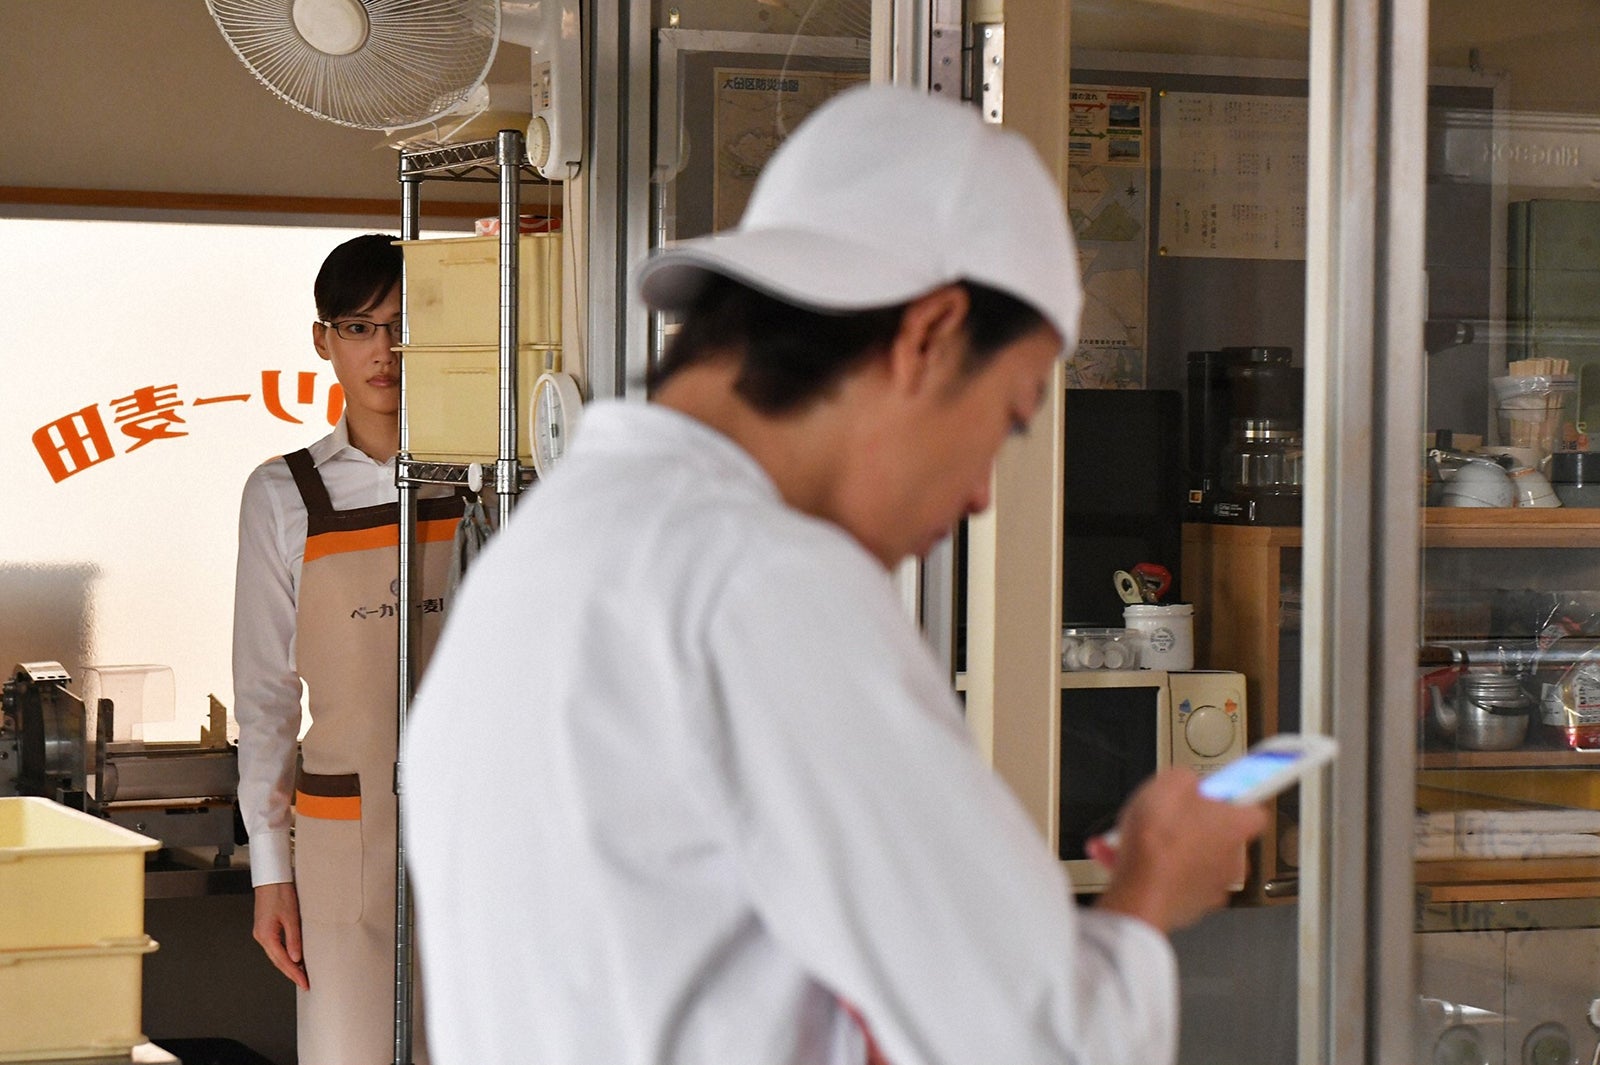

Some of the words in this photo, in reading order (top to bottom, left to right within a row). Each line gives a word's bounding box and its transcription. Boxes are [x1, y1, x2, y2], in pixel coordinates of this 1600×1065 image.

[722, 76, 799, 92] 大田区防災地図
